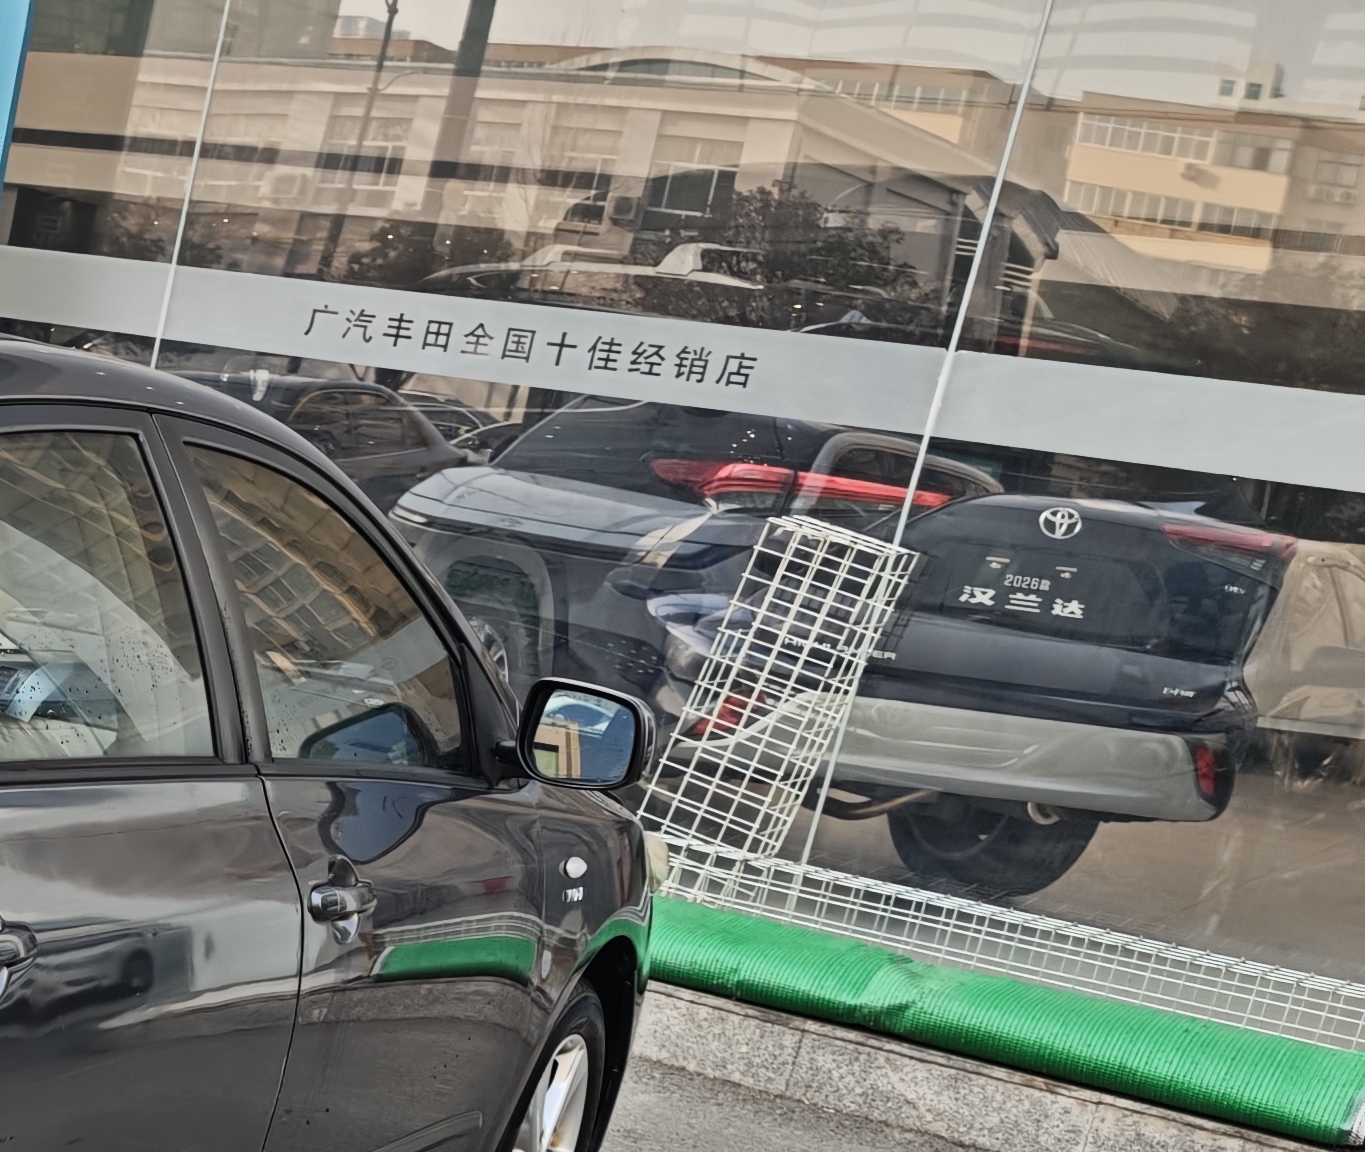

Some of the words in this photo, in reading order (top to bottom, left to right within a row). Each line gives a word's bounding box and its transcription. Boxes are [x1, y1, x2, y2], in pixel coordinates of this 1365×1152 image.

[302, 304, 759, 390] 广汽丰田全国十佳经销店
[958, 585, 1086, 619] 汉兰达
